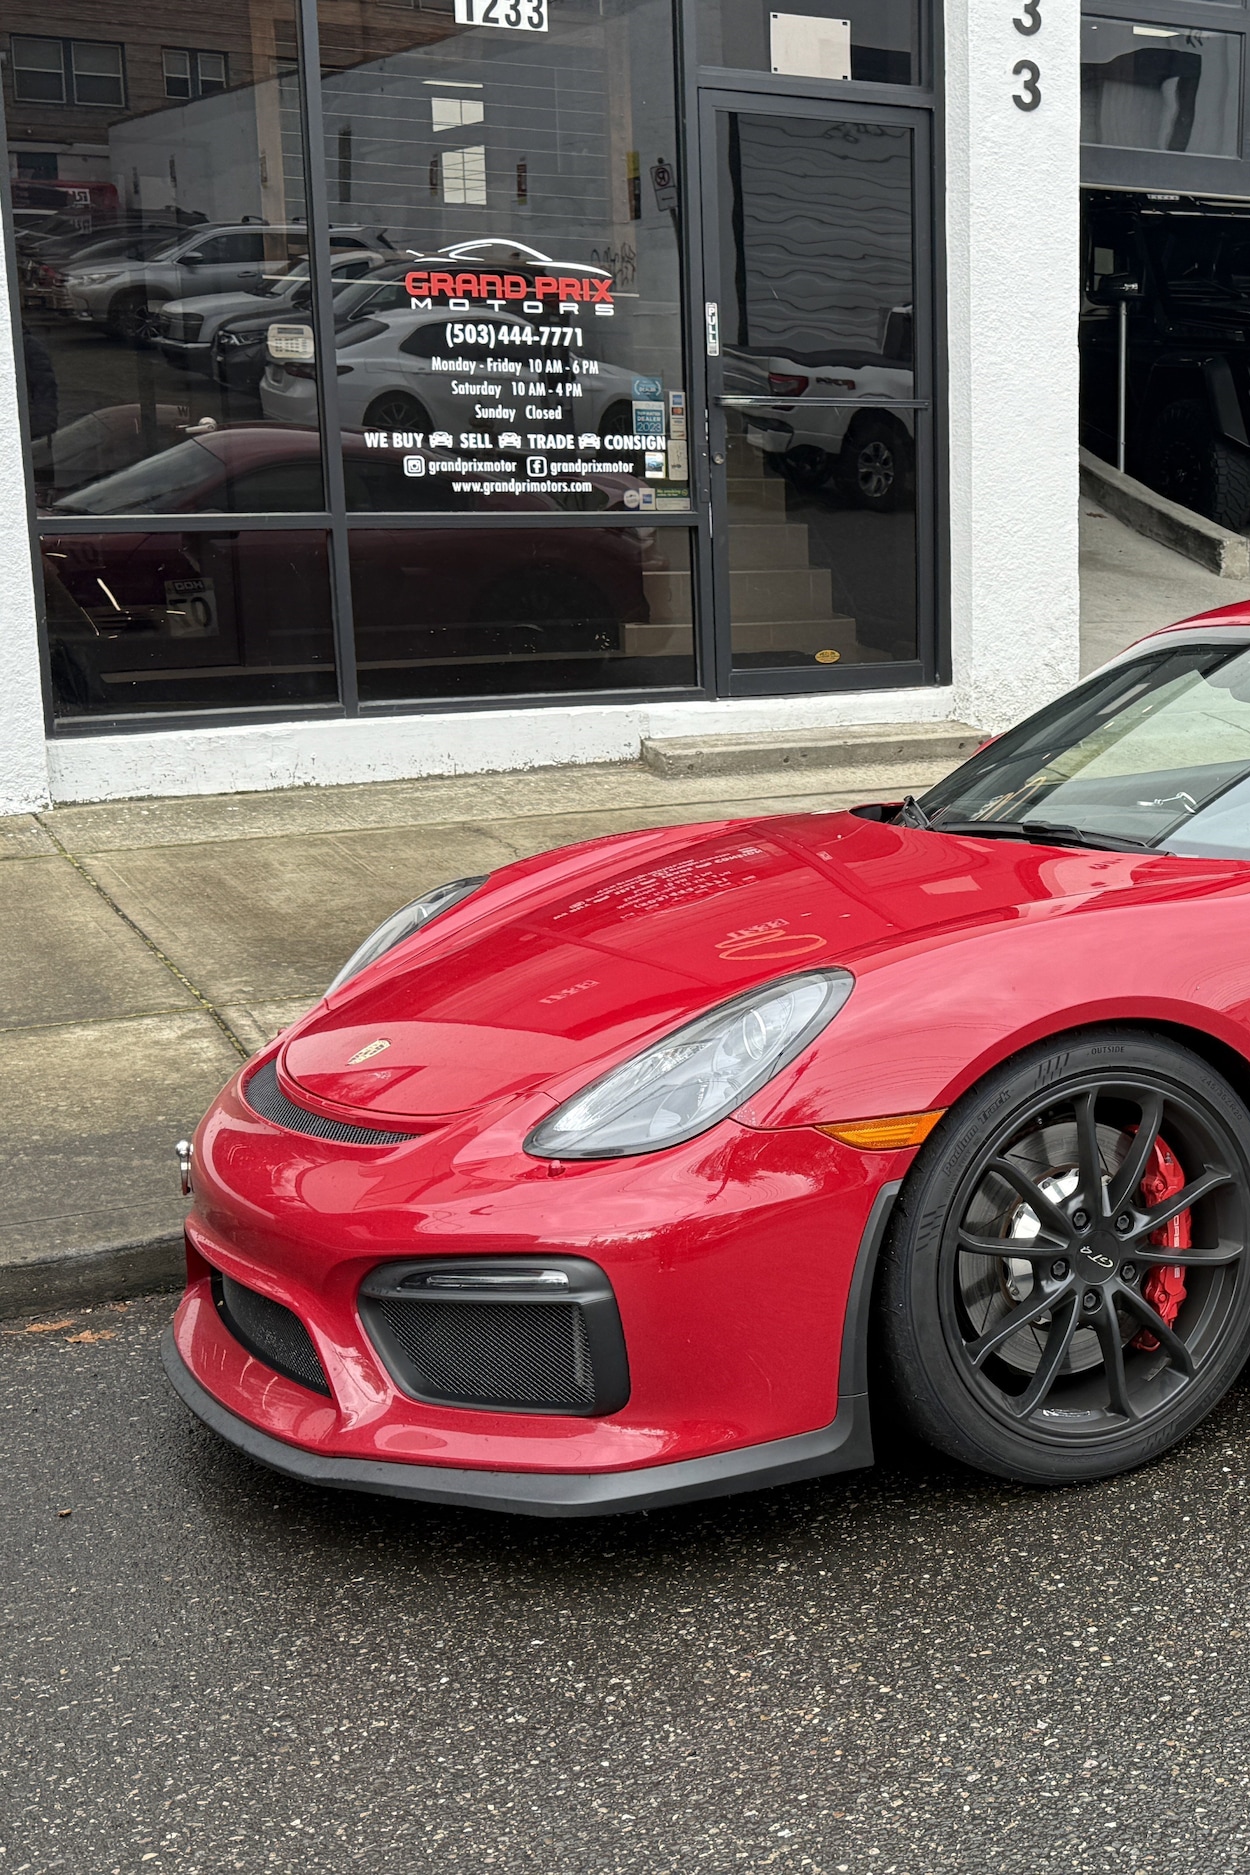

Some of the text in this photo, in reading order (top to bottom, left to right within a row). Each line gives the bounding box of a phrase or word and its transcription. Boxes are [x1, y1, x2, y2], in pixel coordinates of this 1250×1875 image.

[466, 0, 544, 29] 1233
[405, 271, 614, 303] GRAND PRIX
[410, 297, 615, 316] MOTORS
[708, 307, 717, 343] PULL
[431, 356, 477, 376] Monday
[486, 357, 523, 377] Friday
[528, 358, 543, 374] 10
[545, 359, 563, 374] AM
[572, 360, 581, 375] 6
[582, 360, 600, 375] PM
[451, 380, 502, 400] Saturday
[511, 382, 526, 397] 10
[528, 382, 547, 397] AM
[555, 383, 564, 397] 4
[565, 383, 583, 398] PM
[474, 404, 563, 423] Sunday Closed
[637, 422, 662, 432] 2023
[364, 432, 666, 450] WE BUY SELL TRADE CONSIGN
[428, 457, 517, 476] grandprixmotor
[550, 459, 634, 477] grandprixmotor
[452, 478, 593, 496] www.grandprimotors.com
[1091, 1045, 1125, 1055] OUTSIDE
[1080, 1245, 1114, 1268] GT4
[1173, 1214, 1181, 1279] ORSE
